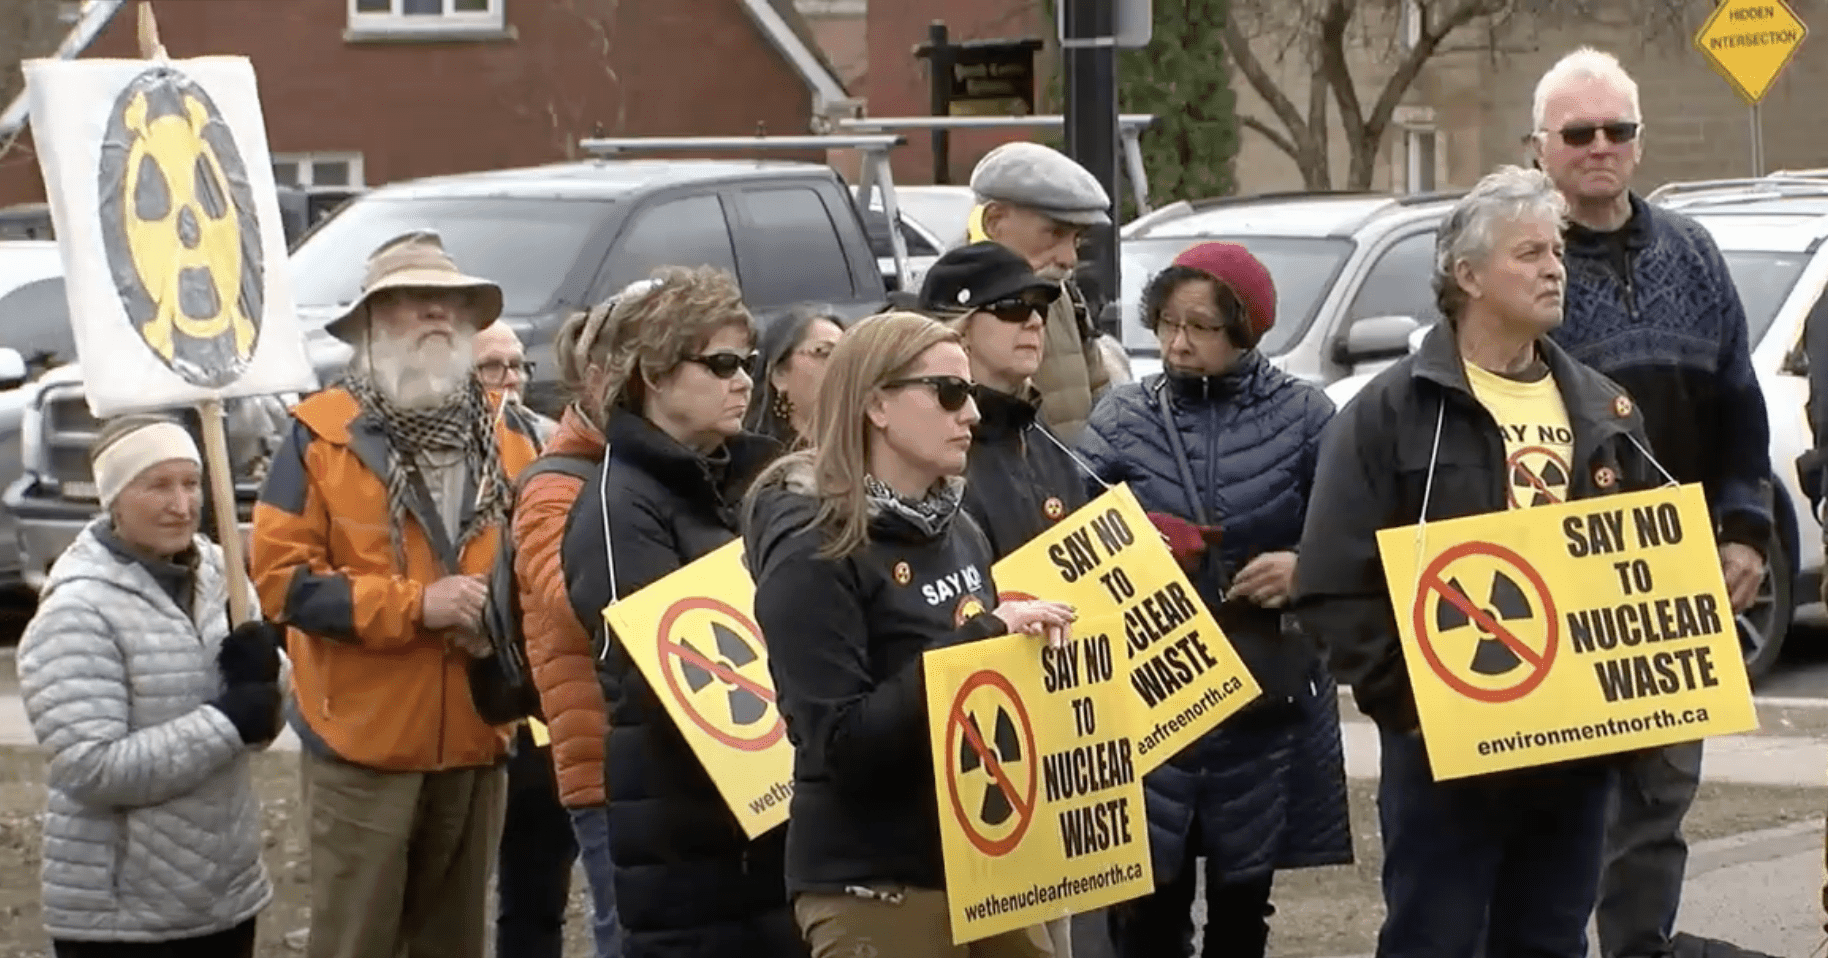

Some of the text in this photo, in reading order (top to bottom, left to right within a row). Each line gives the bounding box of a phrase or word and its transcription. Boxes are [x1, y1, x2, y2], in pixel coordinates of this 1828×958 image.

[1710, 30, 1797, 50] INTERSECTION
[1729, 6, 1774, 21] HIDDEN
[1500, 424, 1571, 443] AY NO
[1049, 508, 1134, 583] SAY NO
[1563, 502, 1683, 558] SAY NO
[922, 573, 961, 605] SAY
[1100, 566, 1135, 604] TO
[1614, 559, 1653, 595] TO
[1124, 581, 1198, 659] CLEAR
[1566, 593, 1722, 654] NUCLEAR
[1042, 633, 1113, 693] SAY NO
[1130, 630, 1218, 709] WASTE
[1594, 647, 1718, 703] WASTE
[1072, 697, 1096, 737] TO
[1137, 675, 1243, 755] earfreenorth.ca
[1478, 708, 1708, 755] environmentnorth.ca
[1042, 737, 1134, 802] NUCLEAR
[1059, 798, 1132, 858] WASTE
[964, 863, 1143, 922] wethenuclearfreenorth.ca
